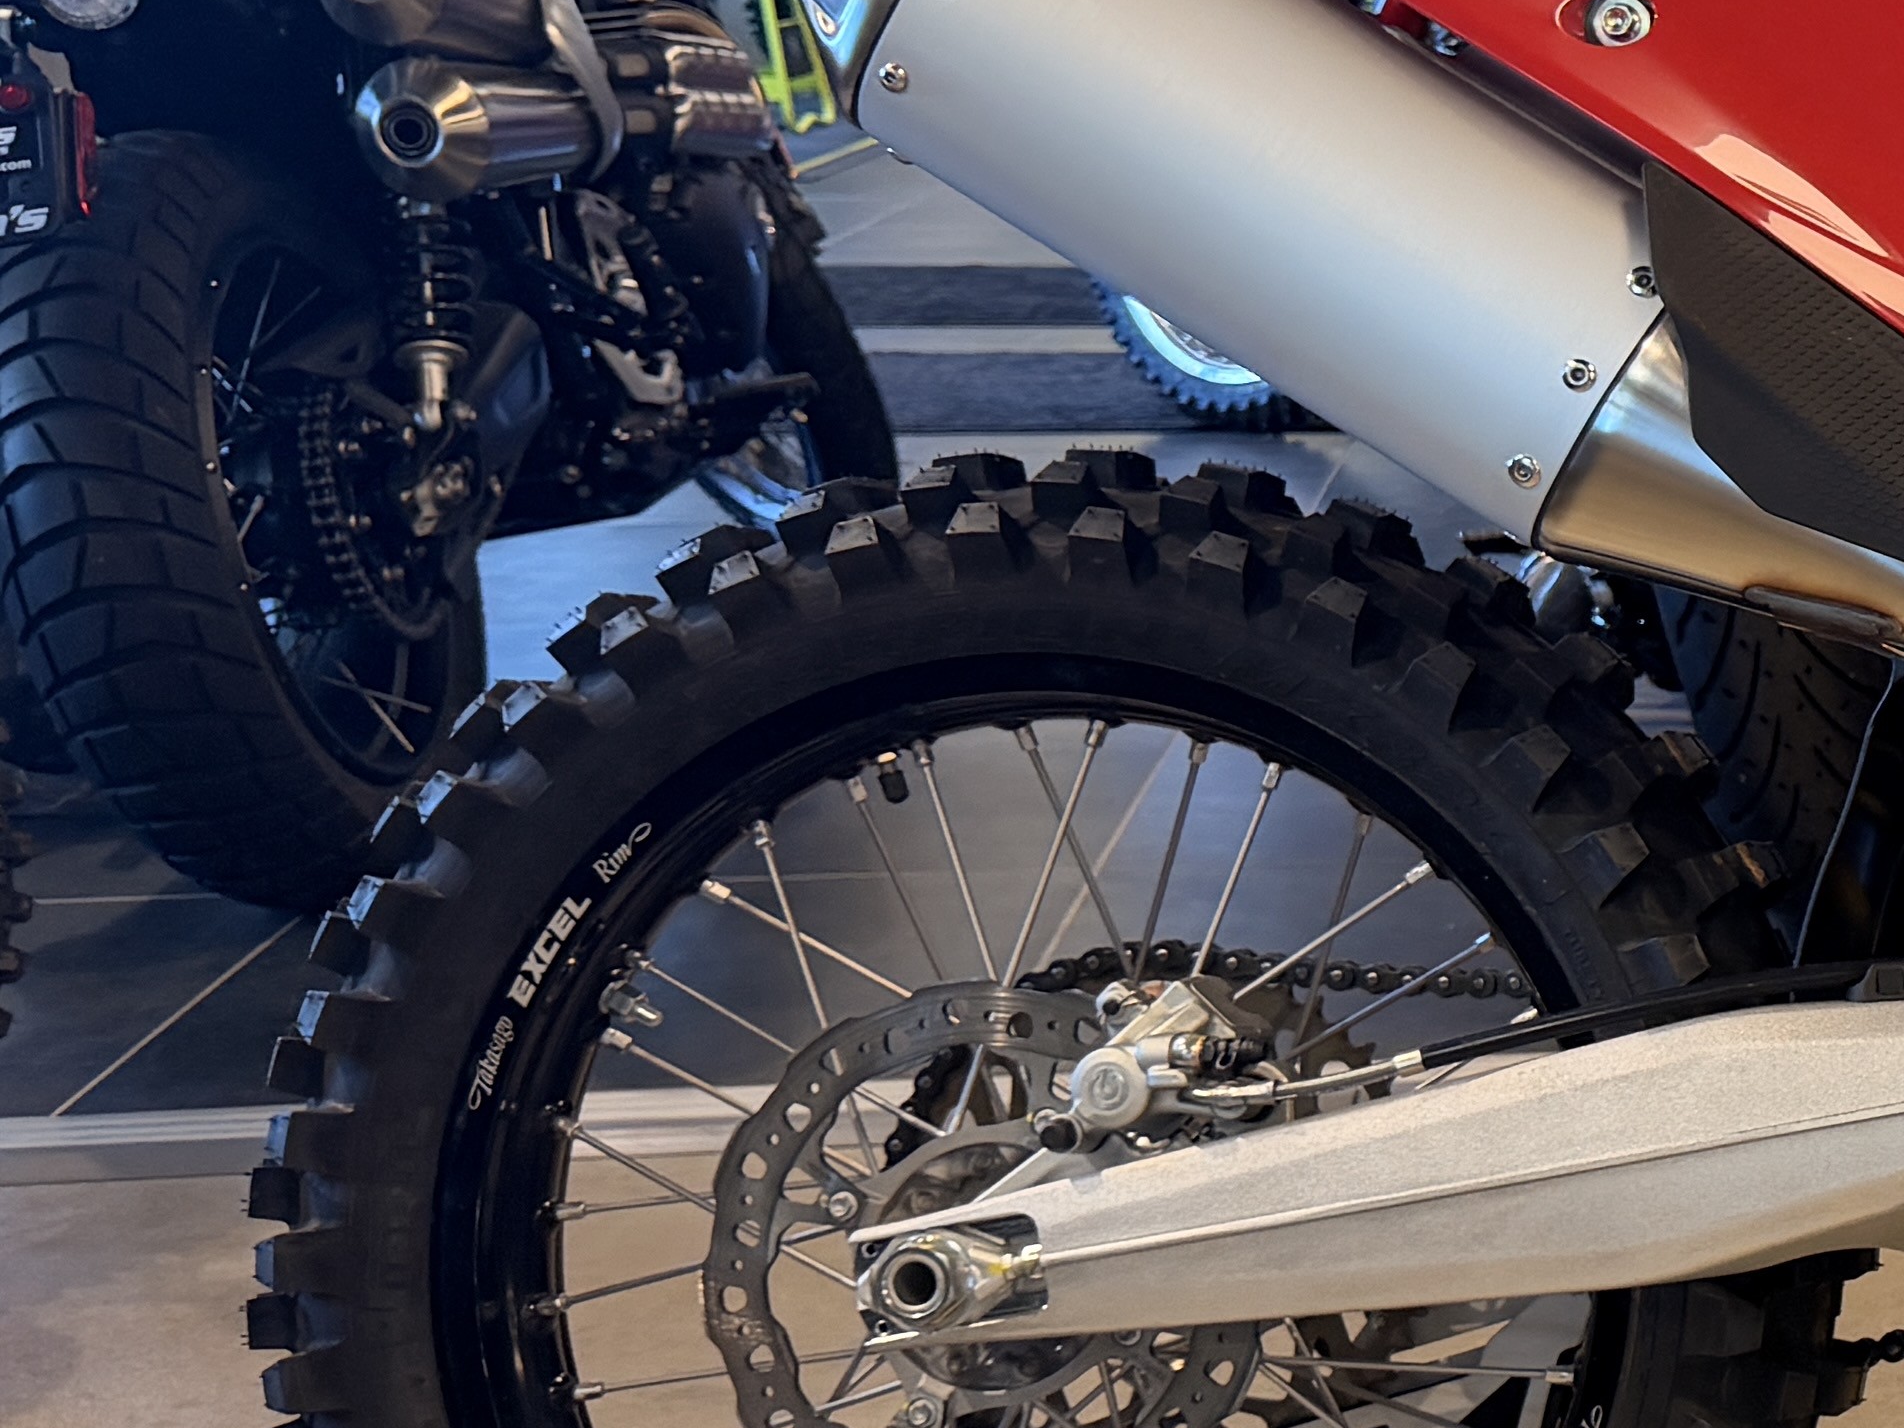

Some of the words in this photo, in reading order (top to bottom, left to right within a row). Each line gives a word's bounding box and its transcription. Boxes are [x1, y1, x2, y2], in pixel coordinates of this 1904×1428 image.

[467, 1015, 514, 1111] Takasago
[506, 896, 593, 1009] EXCEL
[592, 822, 652, 884] Rim
